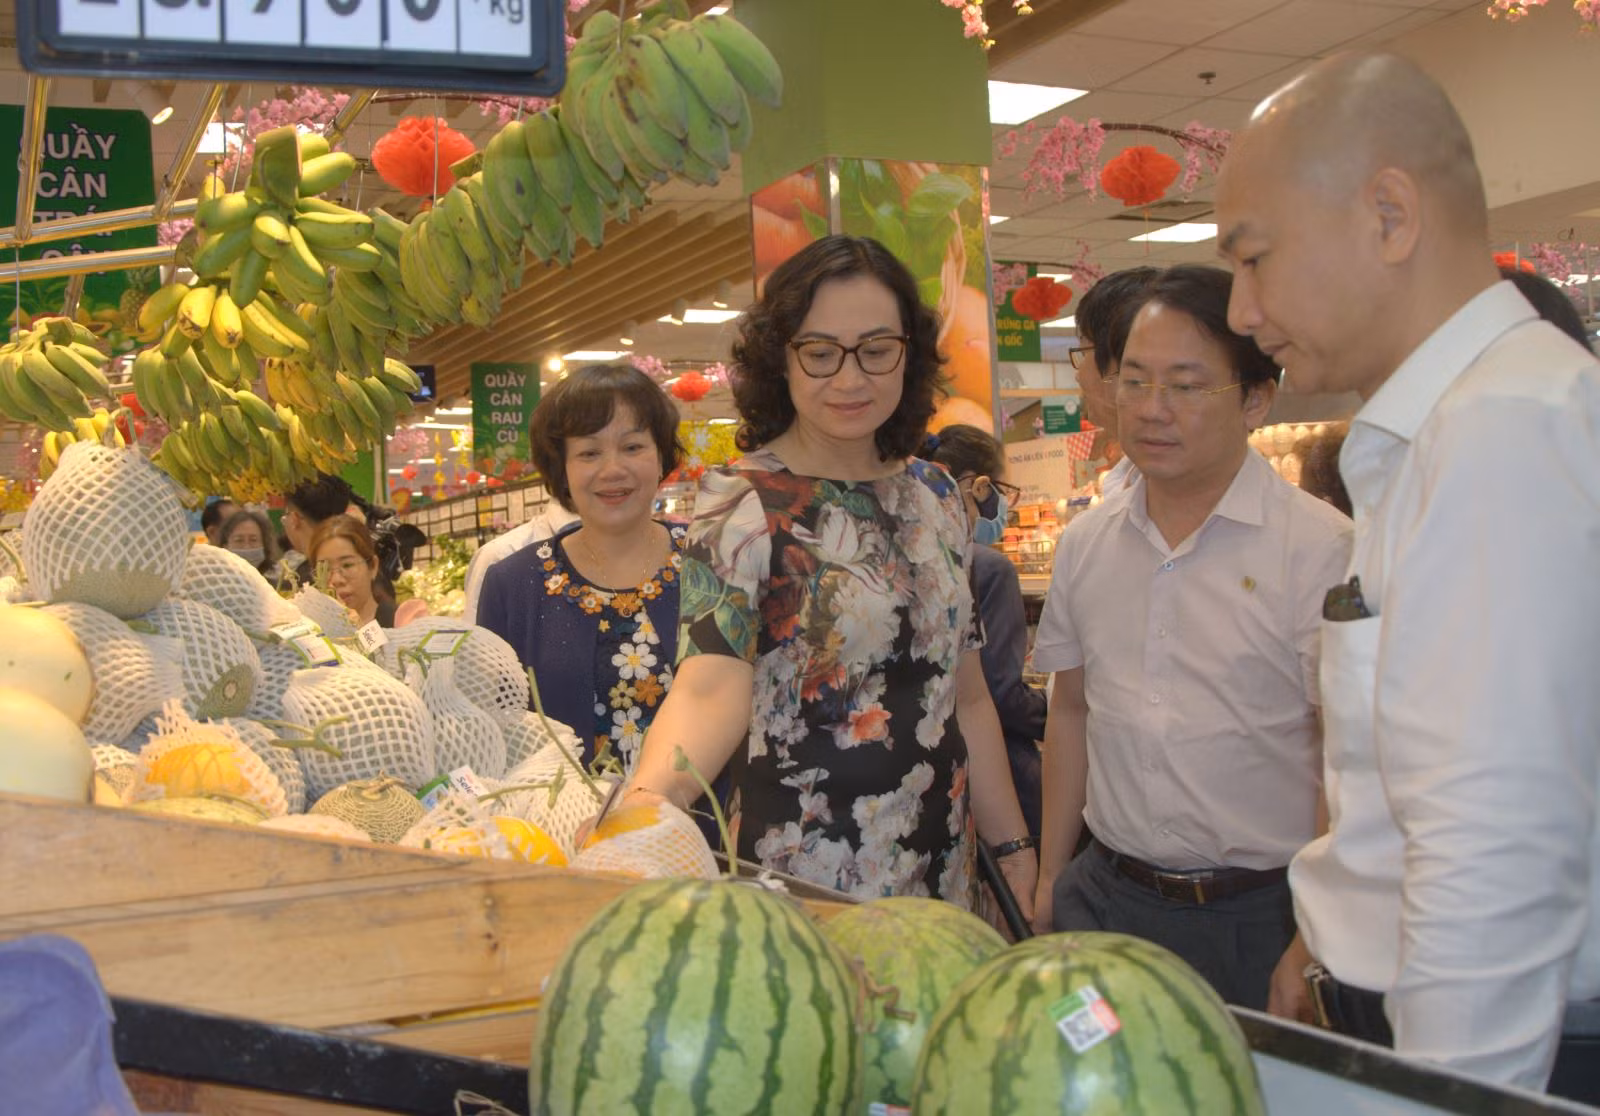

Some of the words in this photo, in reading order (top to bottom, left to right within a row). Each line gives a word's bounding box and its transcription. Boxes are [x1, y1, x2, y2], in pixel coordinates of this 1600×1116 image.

[36, 165, 107, 198] CÂN
[485, 368, 526, 387] QUẦY
[490, 390, 522, 406] CÂN
[491, 412, 522, 424] RAU
